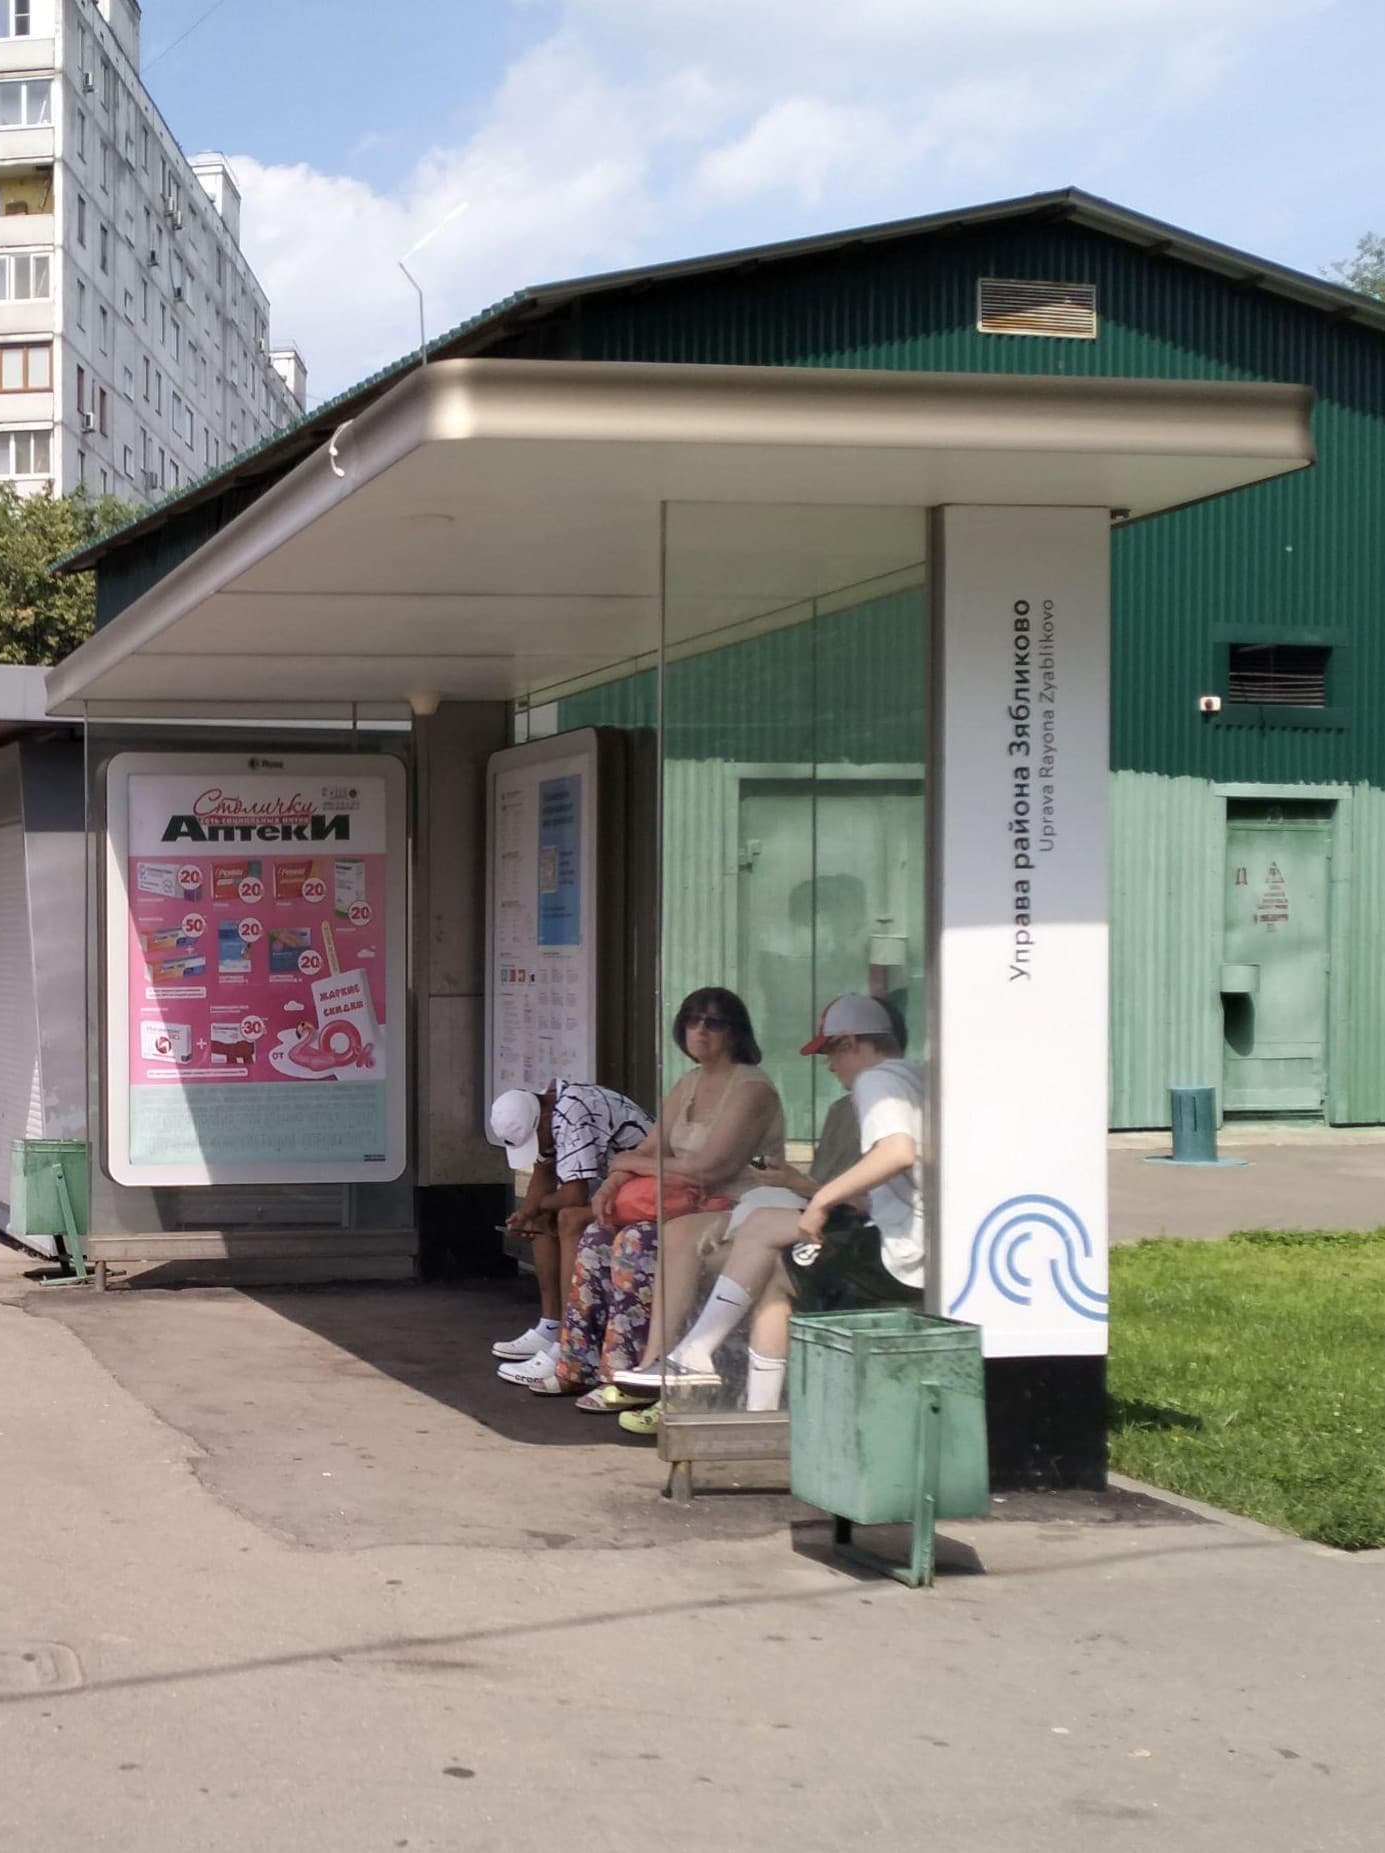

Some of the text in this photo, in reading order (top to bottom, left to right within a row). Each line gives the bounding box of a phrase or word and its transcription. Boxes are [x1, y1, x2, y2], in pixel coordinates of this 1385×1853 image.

[1039, 599, 1057, 852] Uprava Rayona Zyablikovo
[192, 788, 317, 817] Столички
[1008, 599, 1035, 981] Управа района Зябликово
[319, 984, 361, 1001] ЖАРКИЕ
[323, 1000, 364, 1017] СКИДКИ
